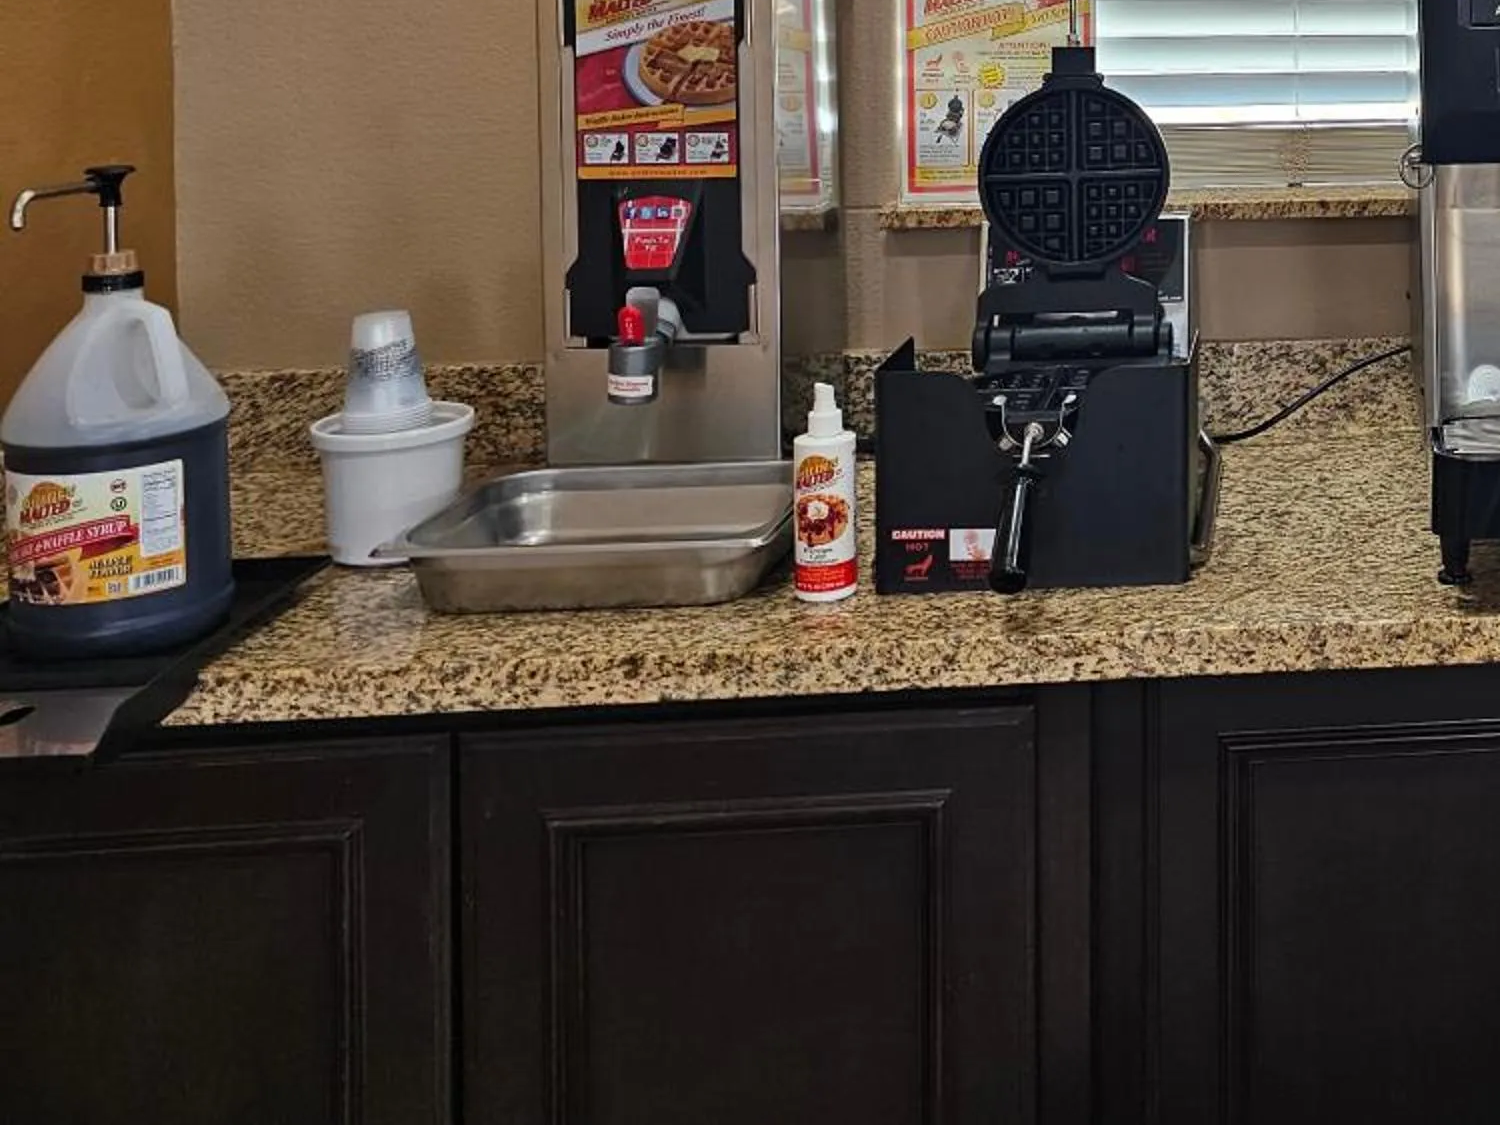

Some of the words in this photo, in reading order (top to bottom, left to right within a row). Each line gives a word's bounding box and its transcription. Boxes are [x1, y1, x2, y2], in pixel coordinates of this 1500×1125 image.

[604, 23, 644, 42] Simply
[86, 520, 128, 539] SYRUP
[891, 529, 945, 540] CAUTION
[905, 542, 929, 552] HOT
